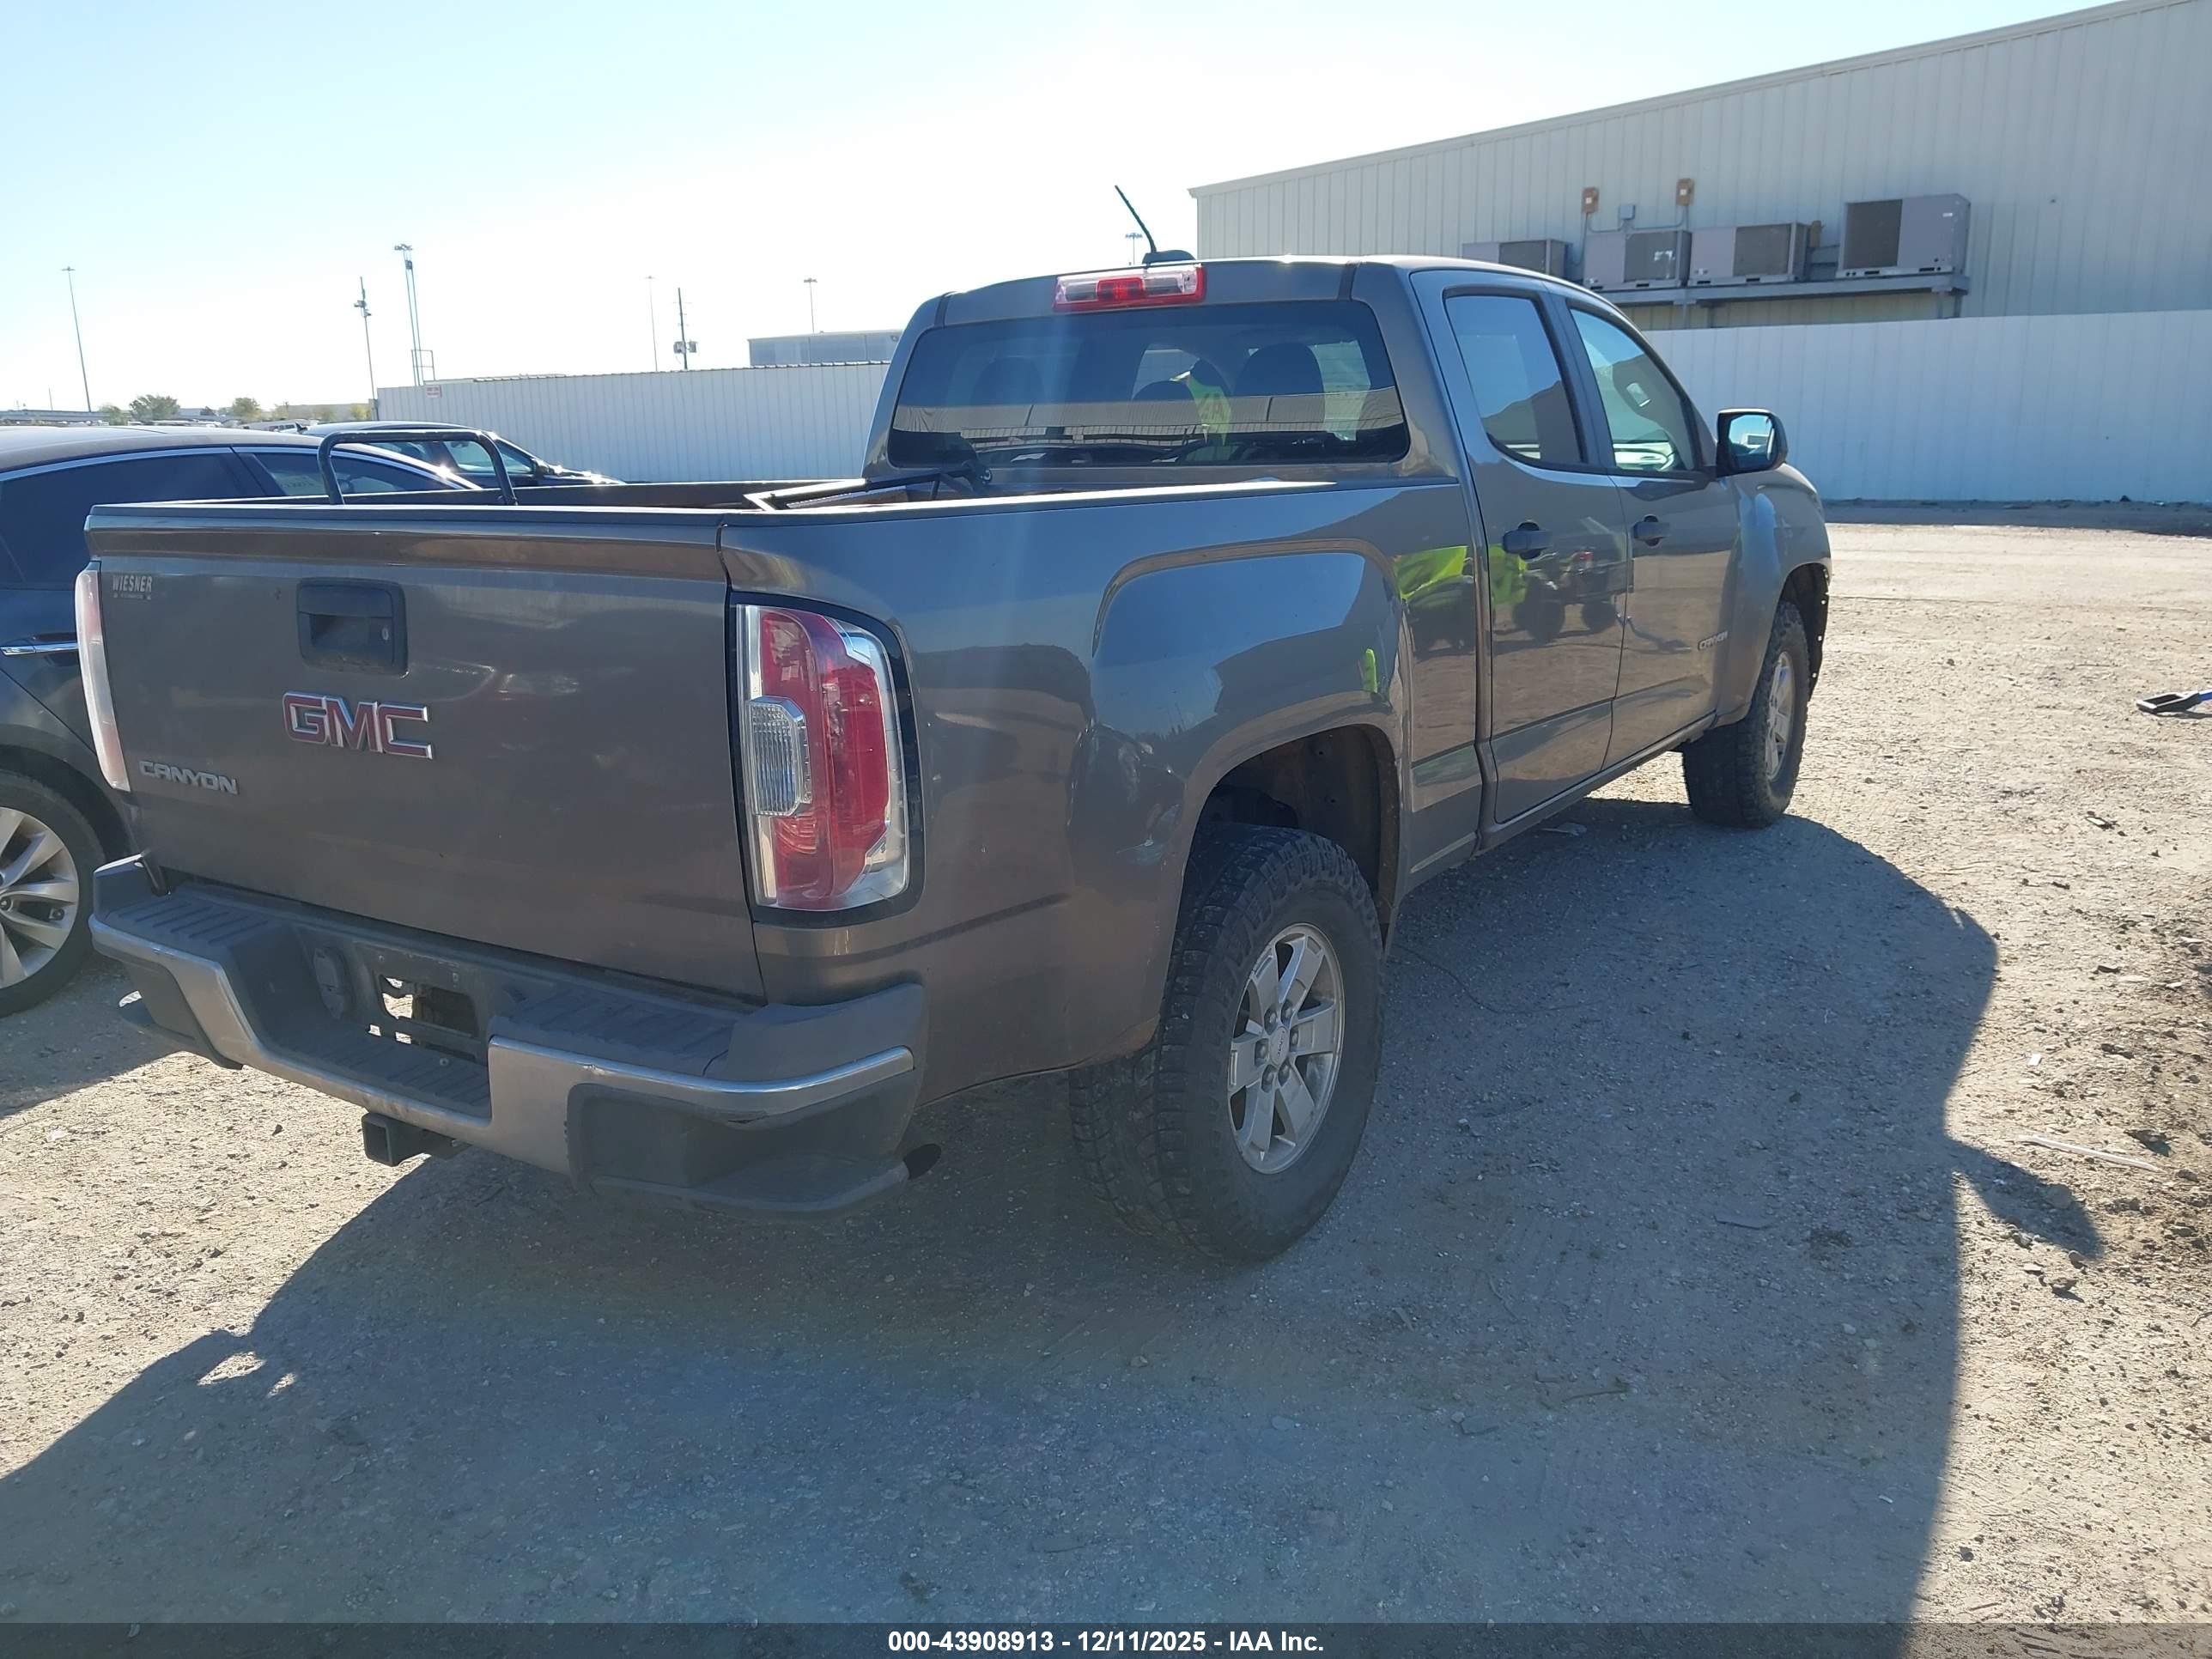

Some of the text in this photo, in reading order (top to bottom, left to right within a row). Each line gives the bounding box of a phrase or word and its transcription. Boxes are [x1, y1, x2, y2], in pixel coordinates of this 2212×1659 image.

[112, 575, 153, 592] WIESNER
[283, 690, 434, 760] GMC
[138, 761, 239, 794] CANYON
